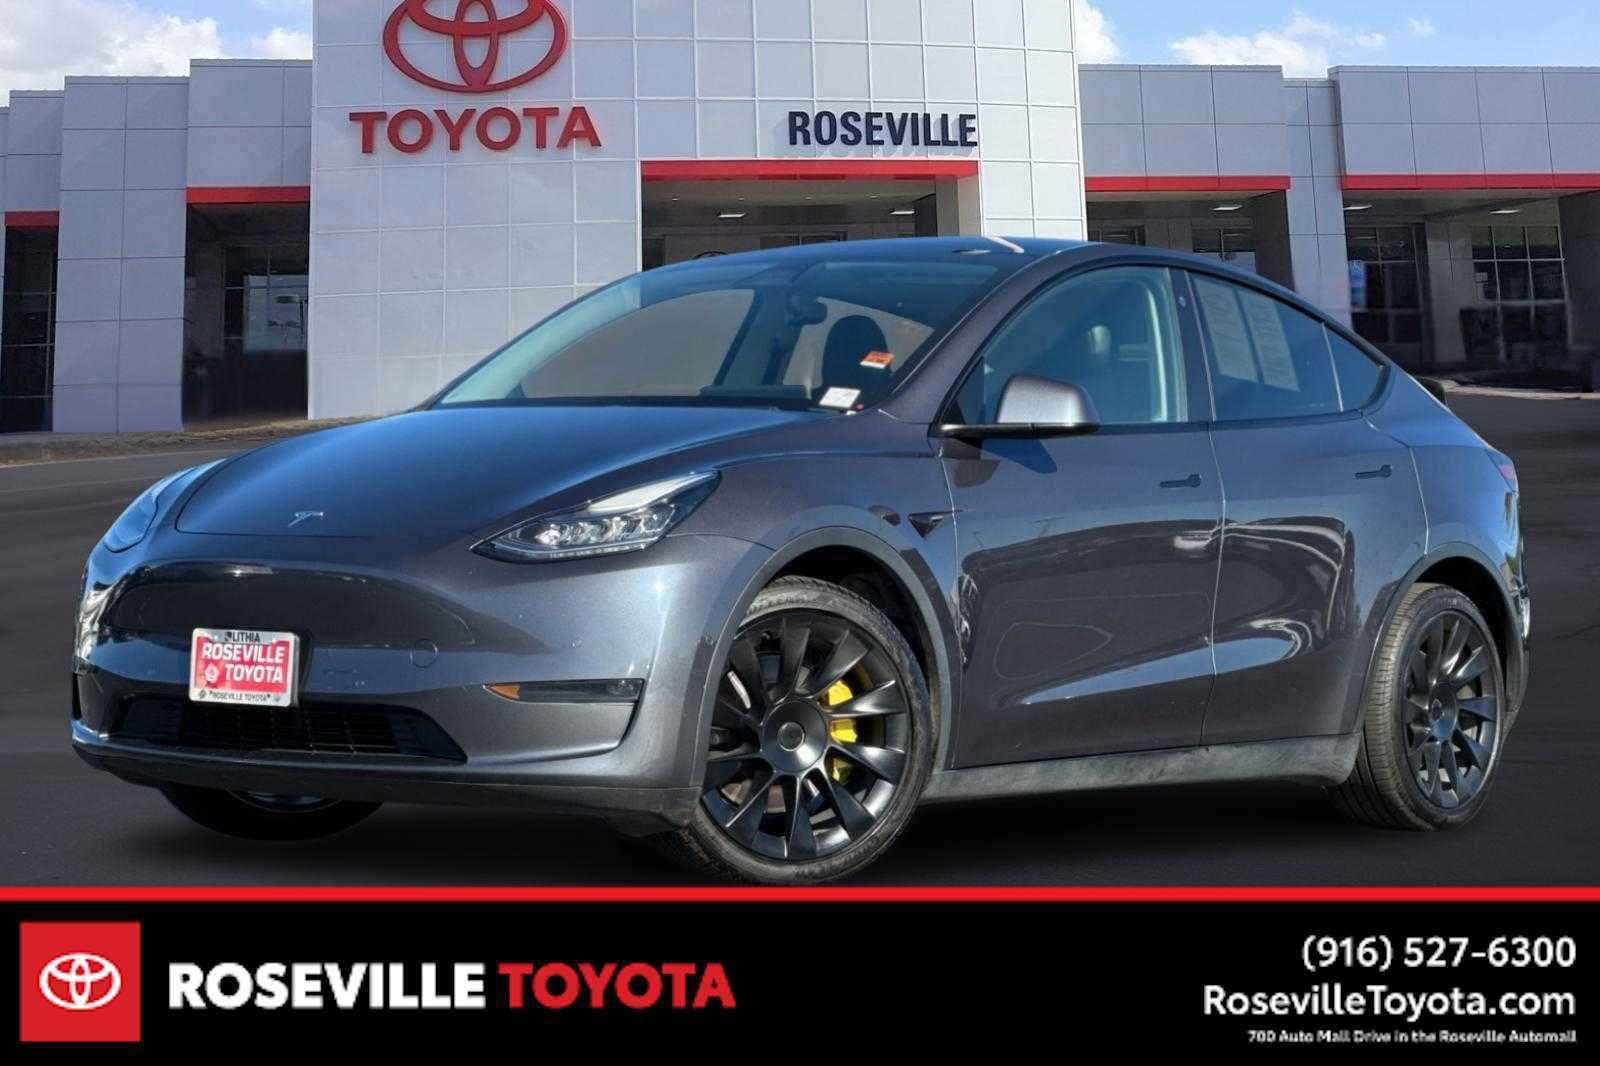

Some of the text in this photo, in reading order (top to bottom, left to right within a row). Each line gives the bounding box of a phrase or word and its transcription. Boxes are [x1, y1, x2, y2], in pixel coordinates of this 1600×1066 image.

[349, 106, 602, 154] TOYOTA
[788, 110, 979, 147] ROSEVILLE
[232, 631, 260, 642] LITHIA
[202, 642, 285, 663] ROSEVILLE
[225, 664, 283, 683] TOYOTA
